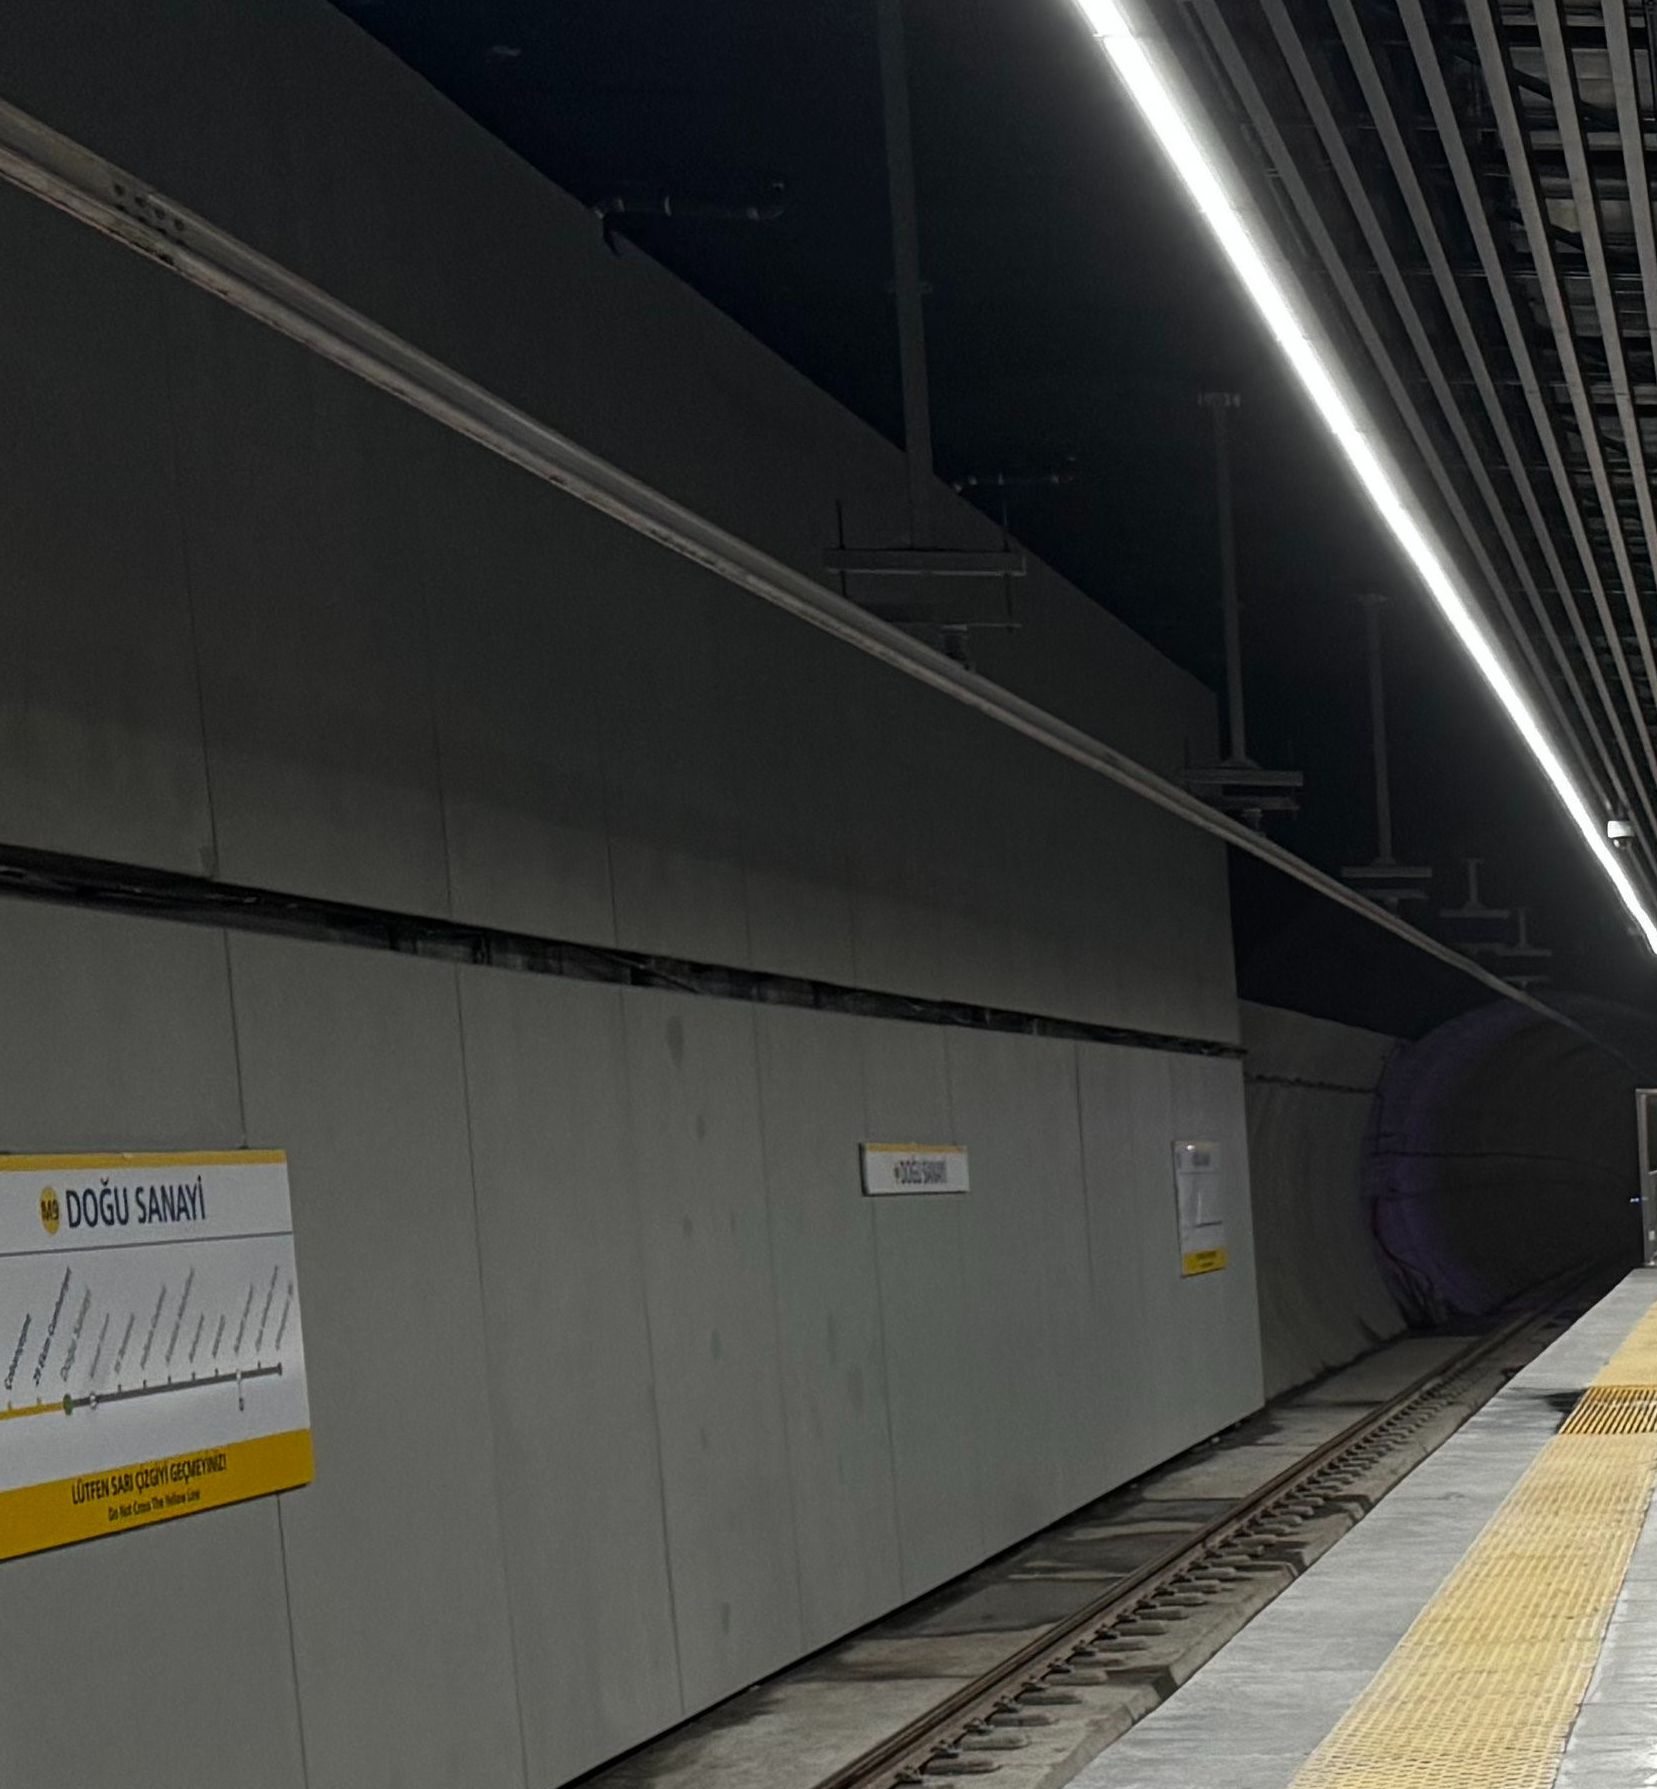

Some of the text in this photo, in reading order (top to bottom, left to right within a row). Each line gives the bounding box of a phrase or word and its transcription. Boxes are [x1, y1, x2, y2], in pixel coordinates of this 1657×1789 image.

[41, 1175, 206, 1228] M9 DOĞU SANAYİ
[72, 1477, 109, 1505] LÜTFEN
[111, 1475, 134, 1496] SARI
